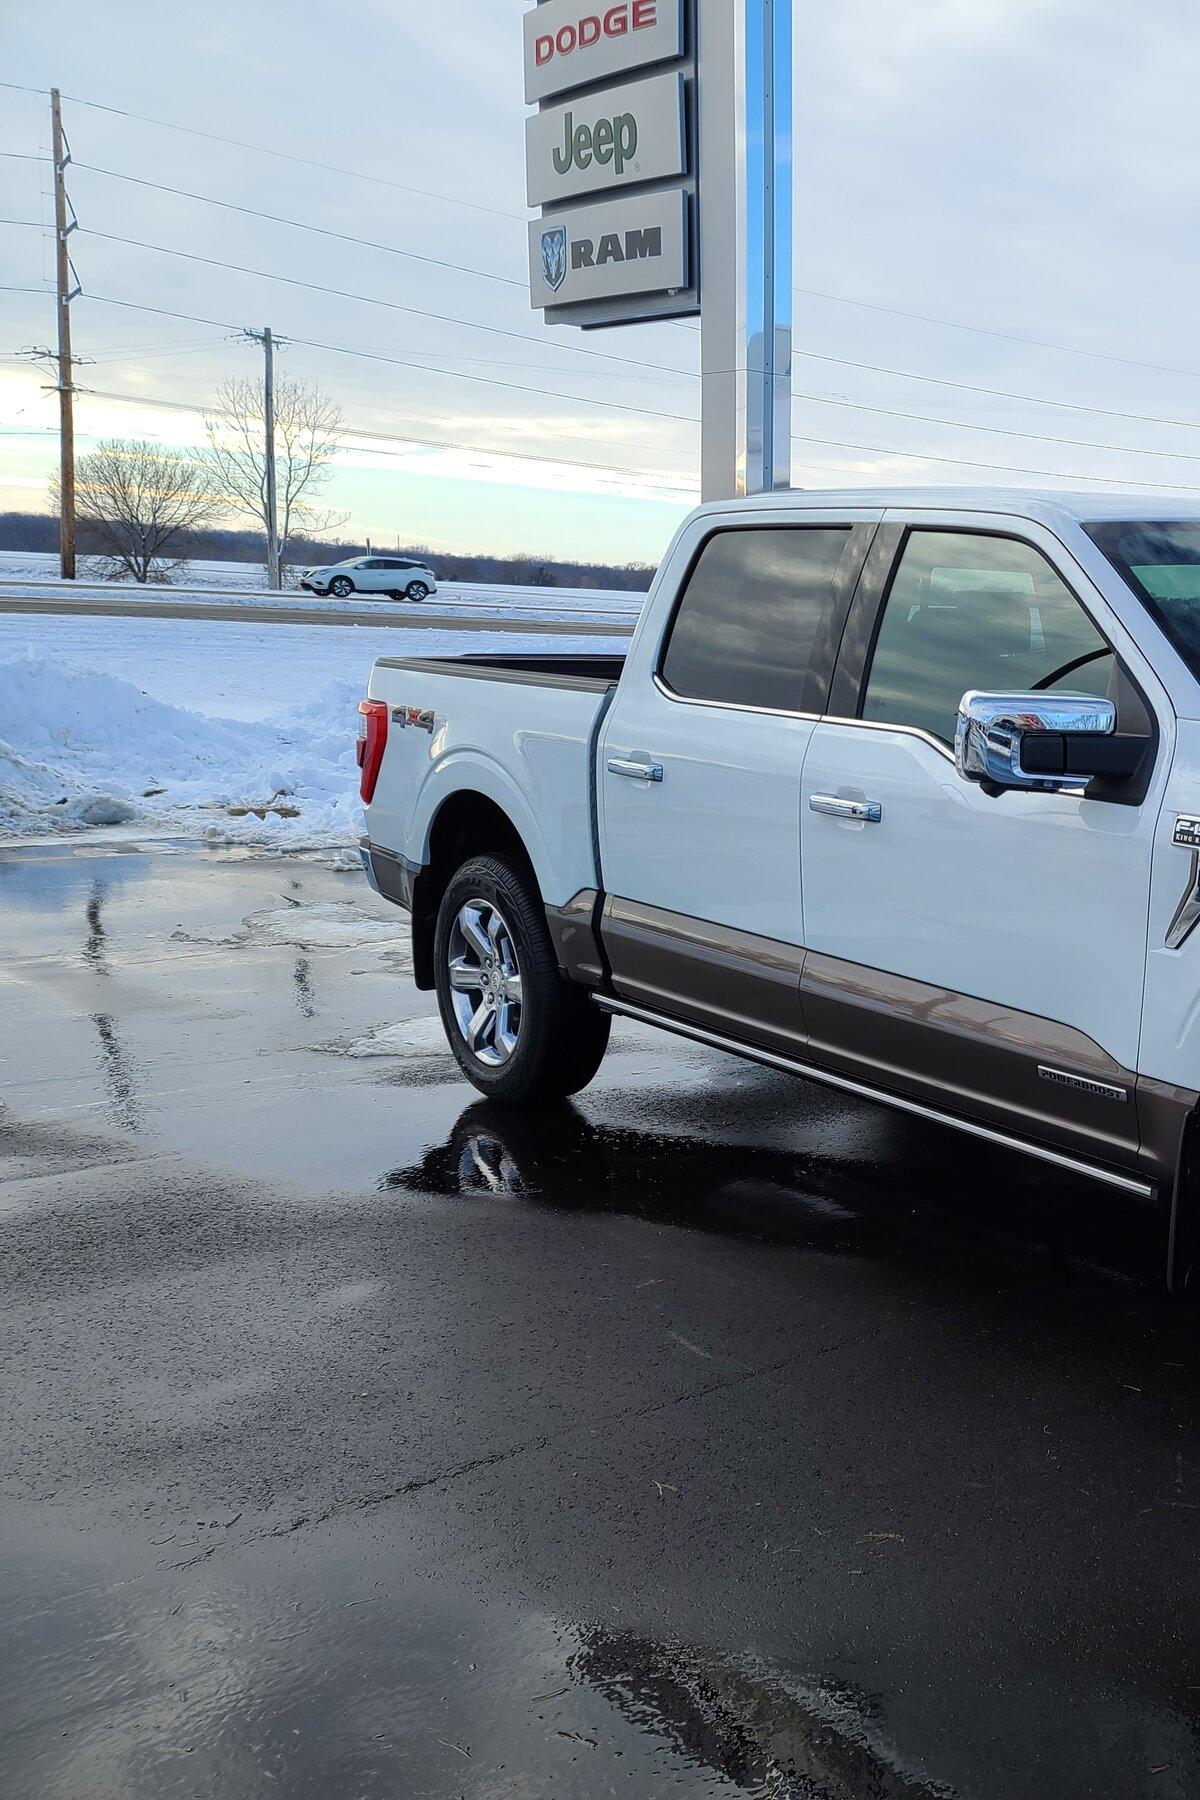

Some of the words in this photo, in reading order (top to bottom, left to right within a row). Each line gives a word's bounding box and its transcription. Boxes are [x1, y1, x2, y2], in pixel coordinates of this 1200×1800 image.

[535, 0, 658, 67] DODGE
[552, 111, 638, 175] Jeep
[570, 226, 662, 270] RAM
[1175, 833, 1193, 843] KING
[1041, 1069, 1121, 1099] POWERBOOST
